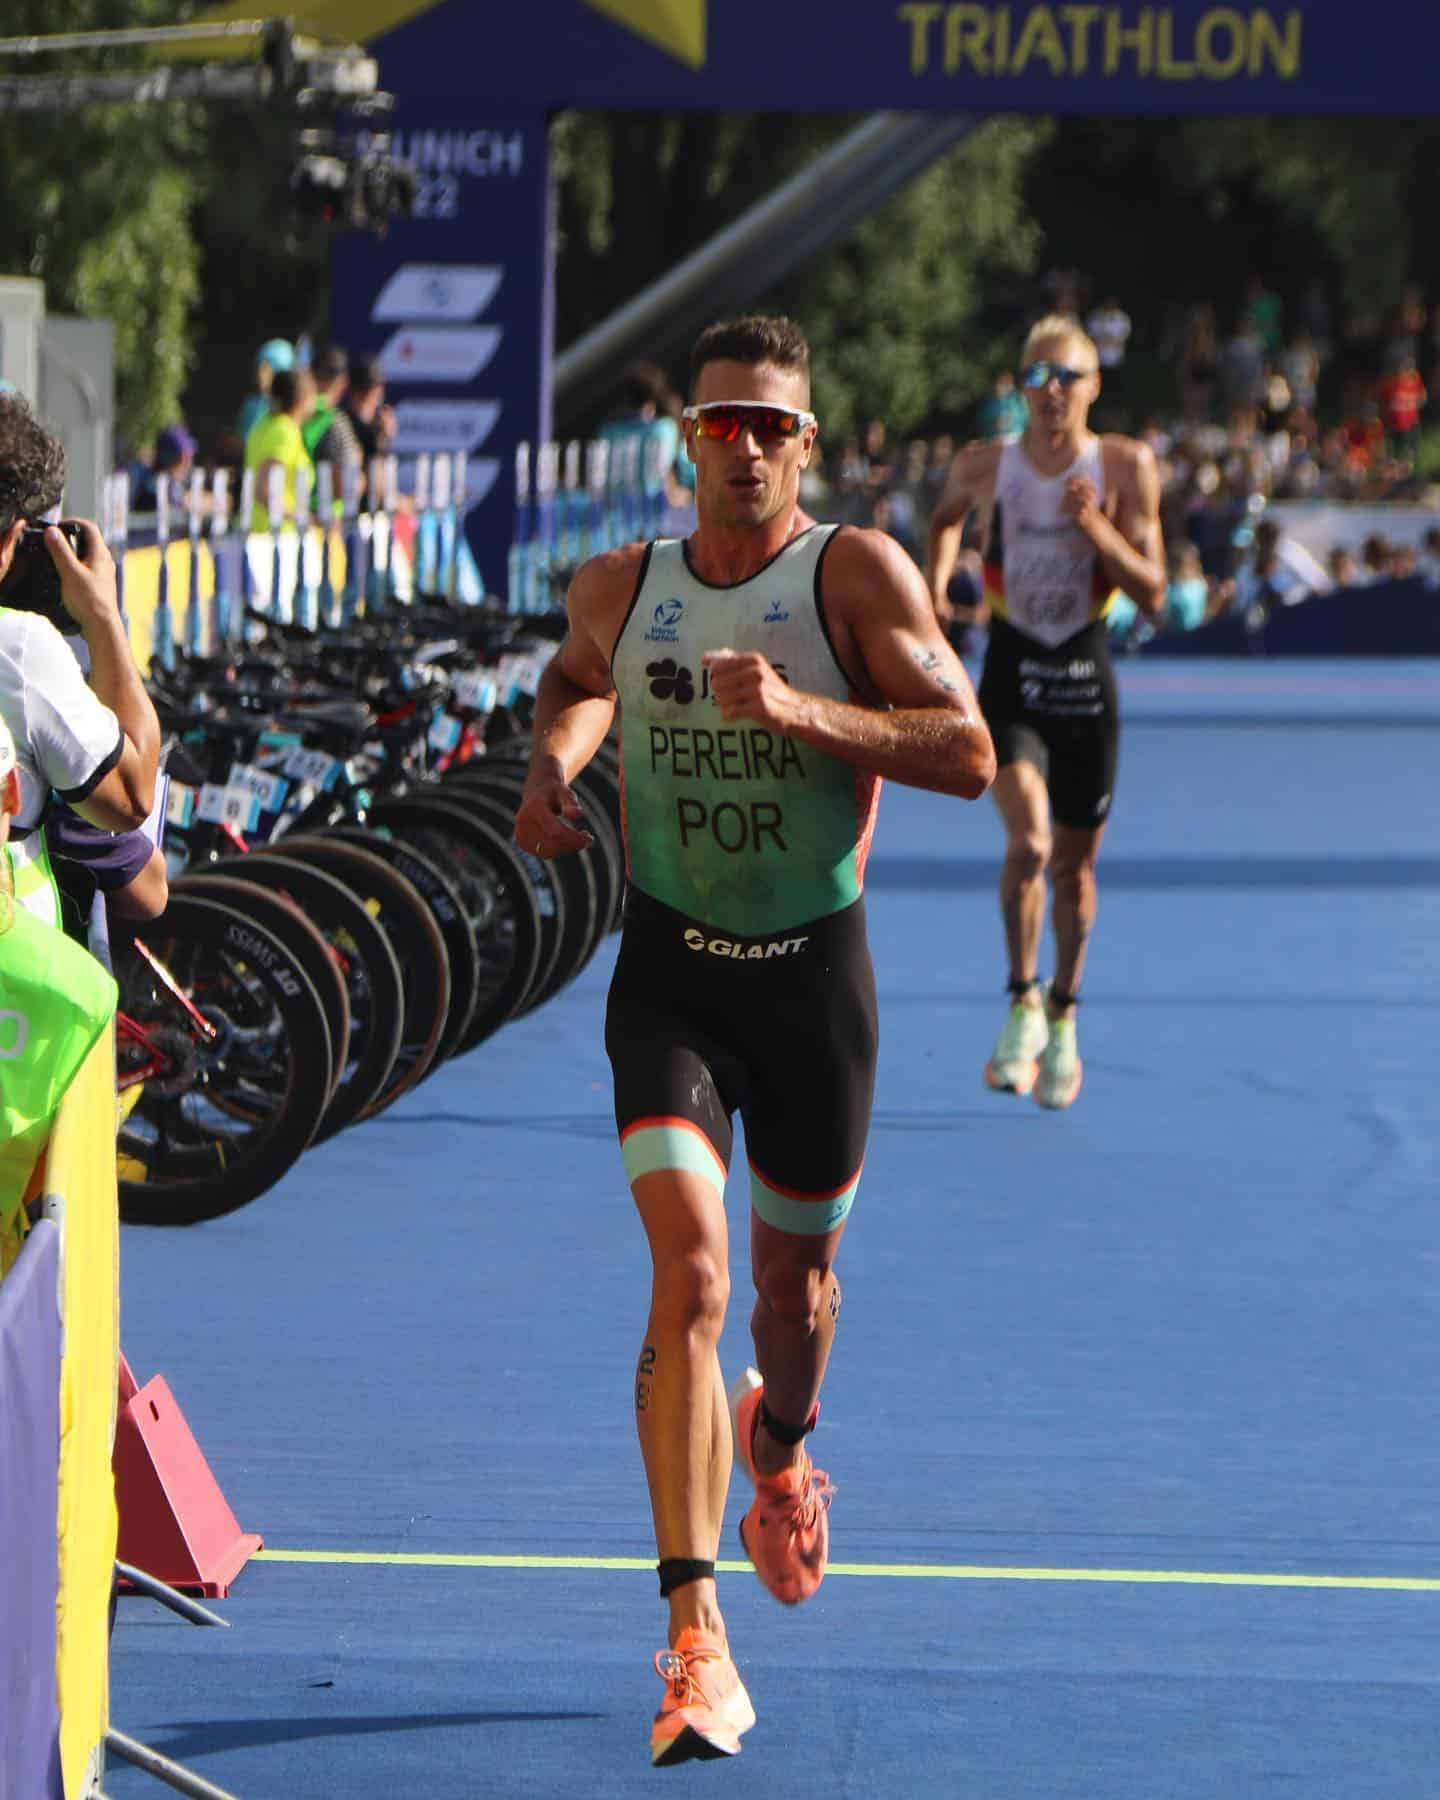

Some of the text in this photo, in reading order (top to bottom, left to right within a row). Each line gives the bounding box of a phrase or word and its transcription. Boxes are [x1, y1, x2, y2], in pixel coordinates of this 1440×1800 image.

[899, 4, 1300, 79] TRIATHLON
[649, 725, 806, 779] PEREIRA
[676, 797, 787, 853] POR
[708, 936, 809, 960] GIANT
